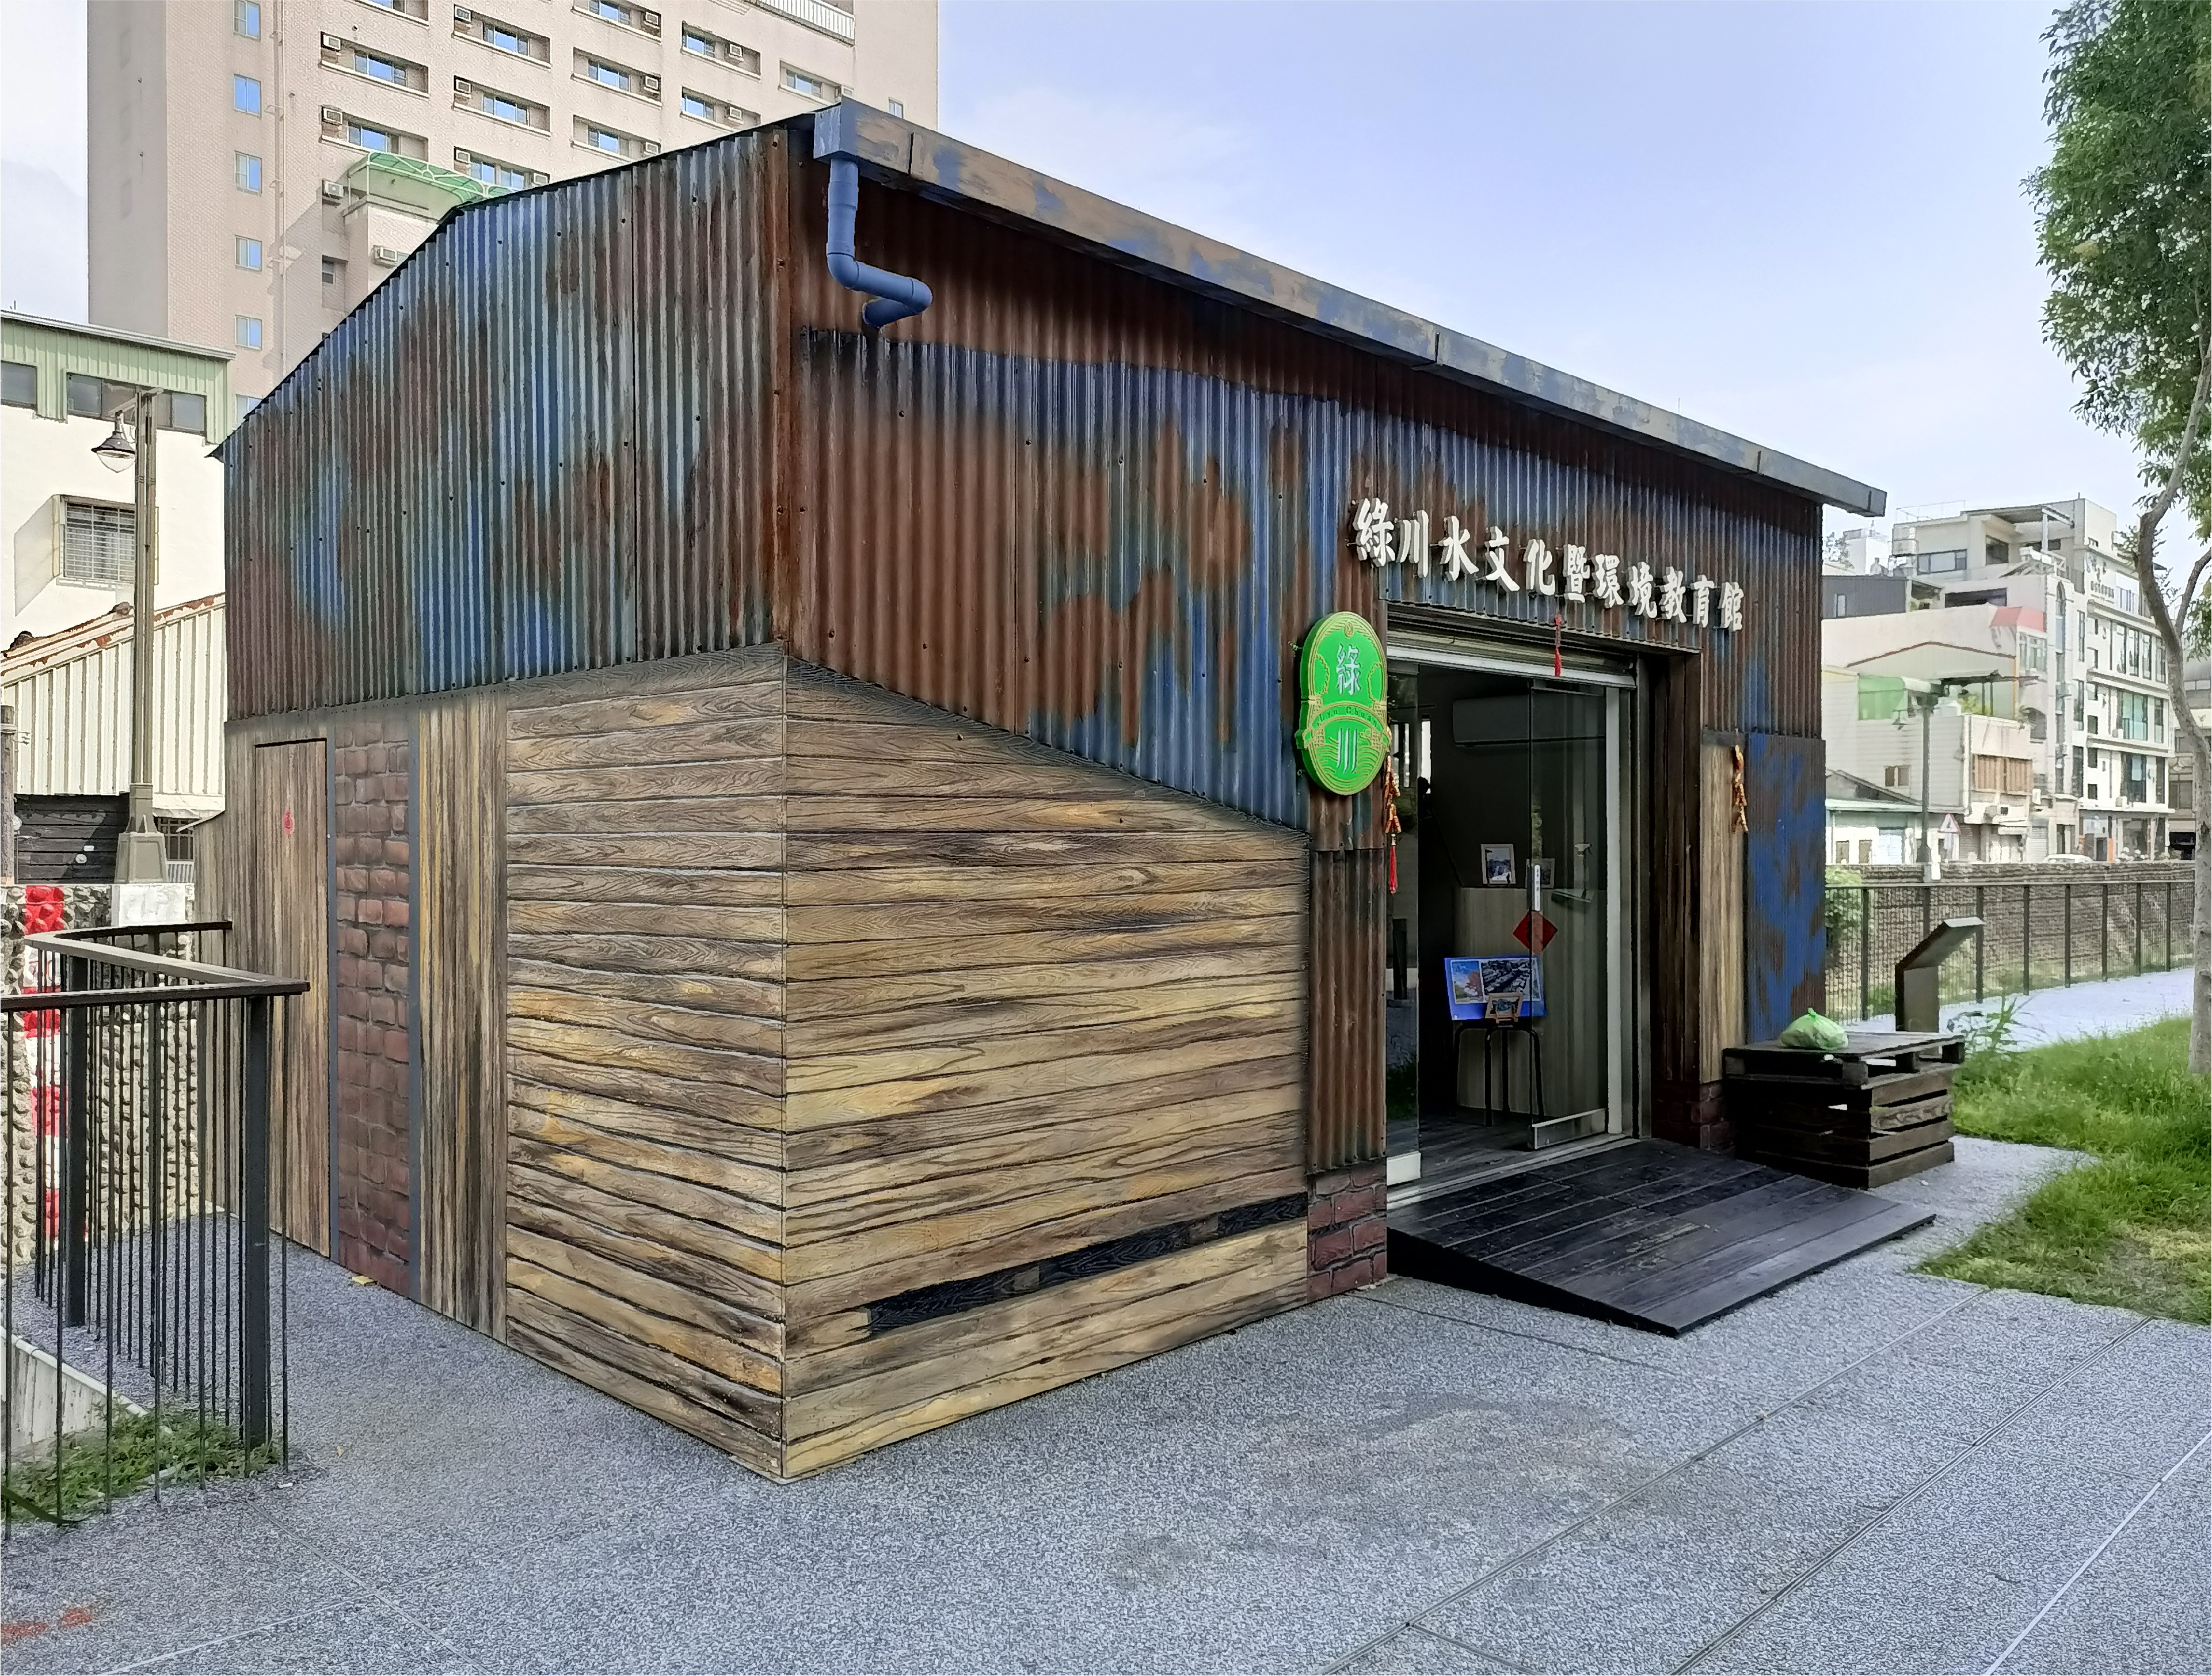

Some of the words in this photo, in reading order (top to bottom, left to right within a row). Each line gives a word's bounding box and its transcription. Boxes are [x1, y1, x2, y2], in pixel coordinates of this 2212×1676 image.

[1353, 497, 1744, 632] 綠川水文化暨環境教育館
[1336, 643, 1361, 695] 綠
[1319, 710, 1338, 722] Lyu
[1346, 706, 1377, 727] Chuan
[1336, 727, 1358, 774] 川
